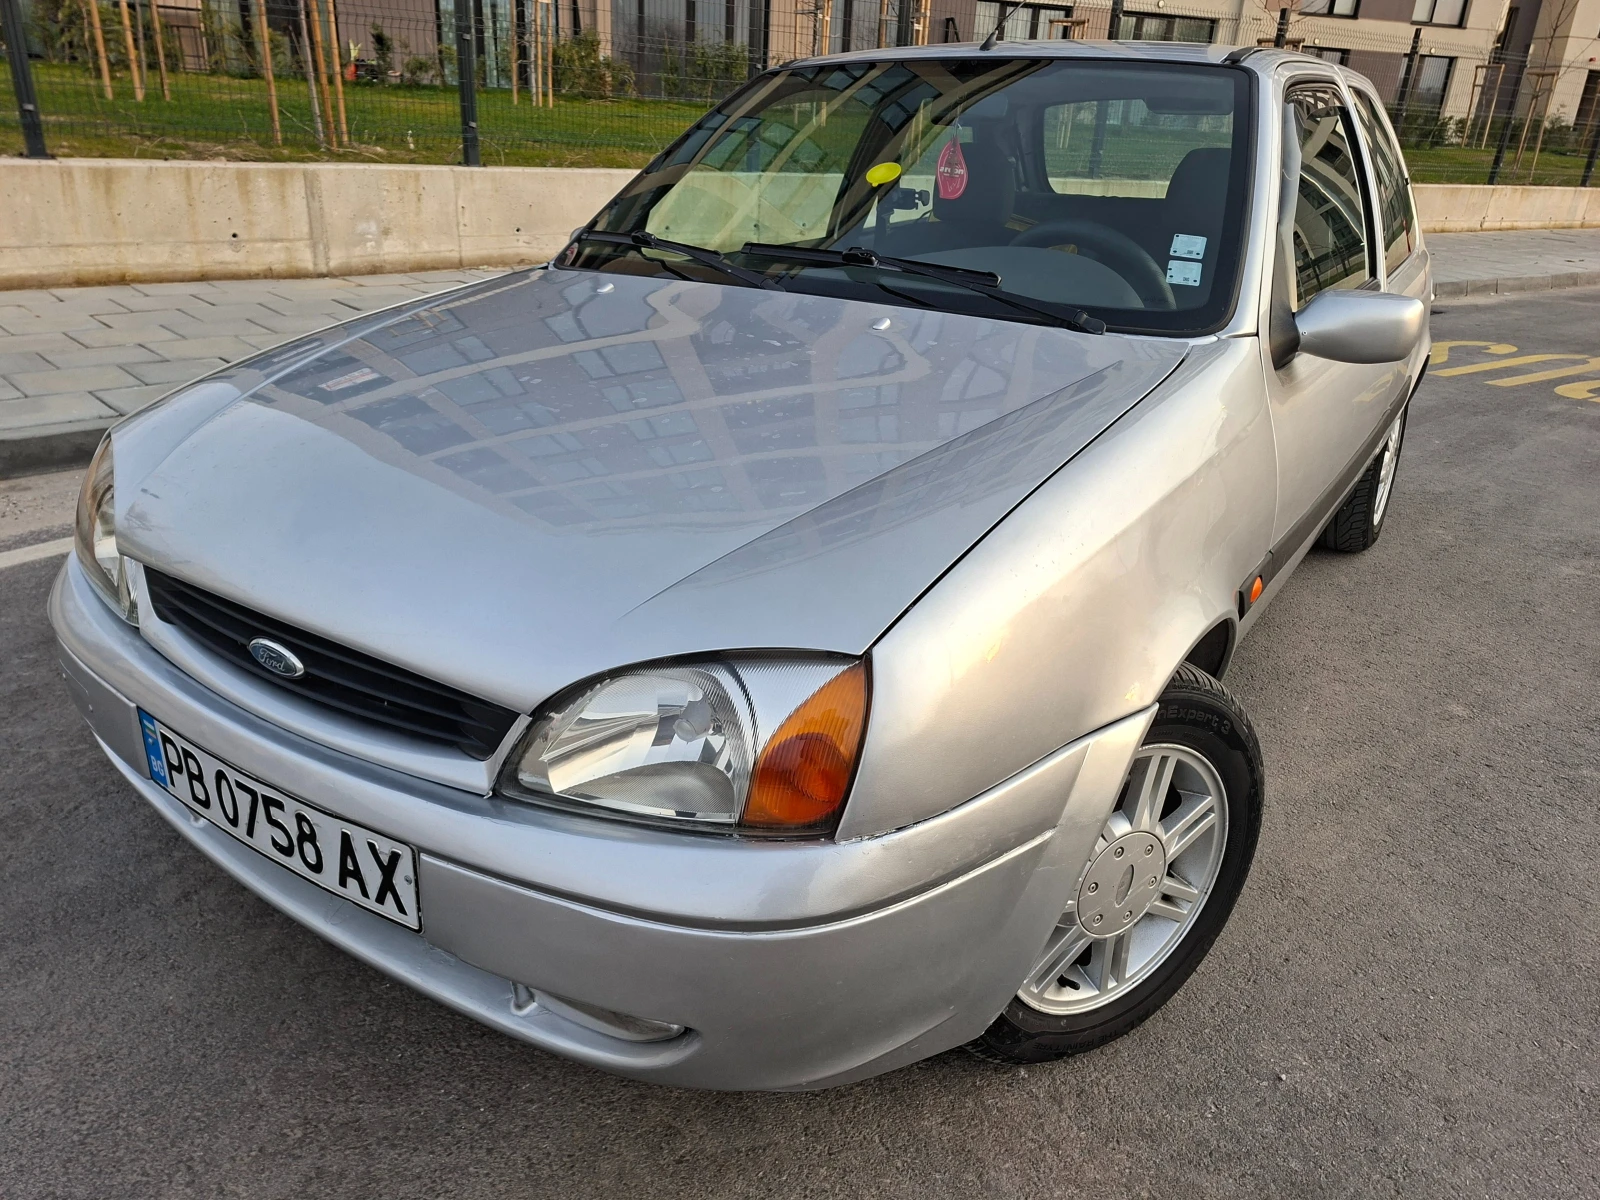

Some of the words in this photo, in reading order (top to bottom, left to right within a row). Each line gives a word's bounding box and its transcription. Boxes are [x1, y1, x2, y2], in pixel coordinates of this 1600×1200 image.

[940, 166, 964, 175] aron
[259, 647, 286, 672] Ford
[150, 755, 165, 778] BG
[160, 729, 211, 810] PB
[215, 768, 324, 874] 0758
[338, 828, 408, 916] AX
